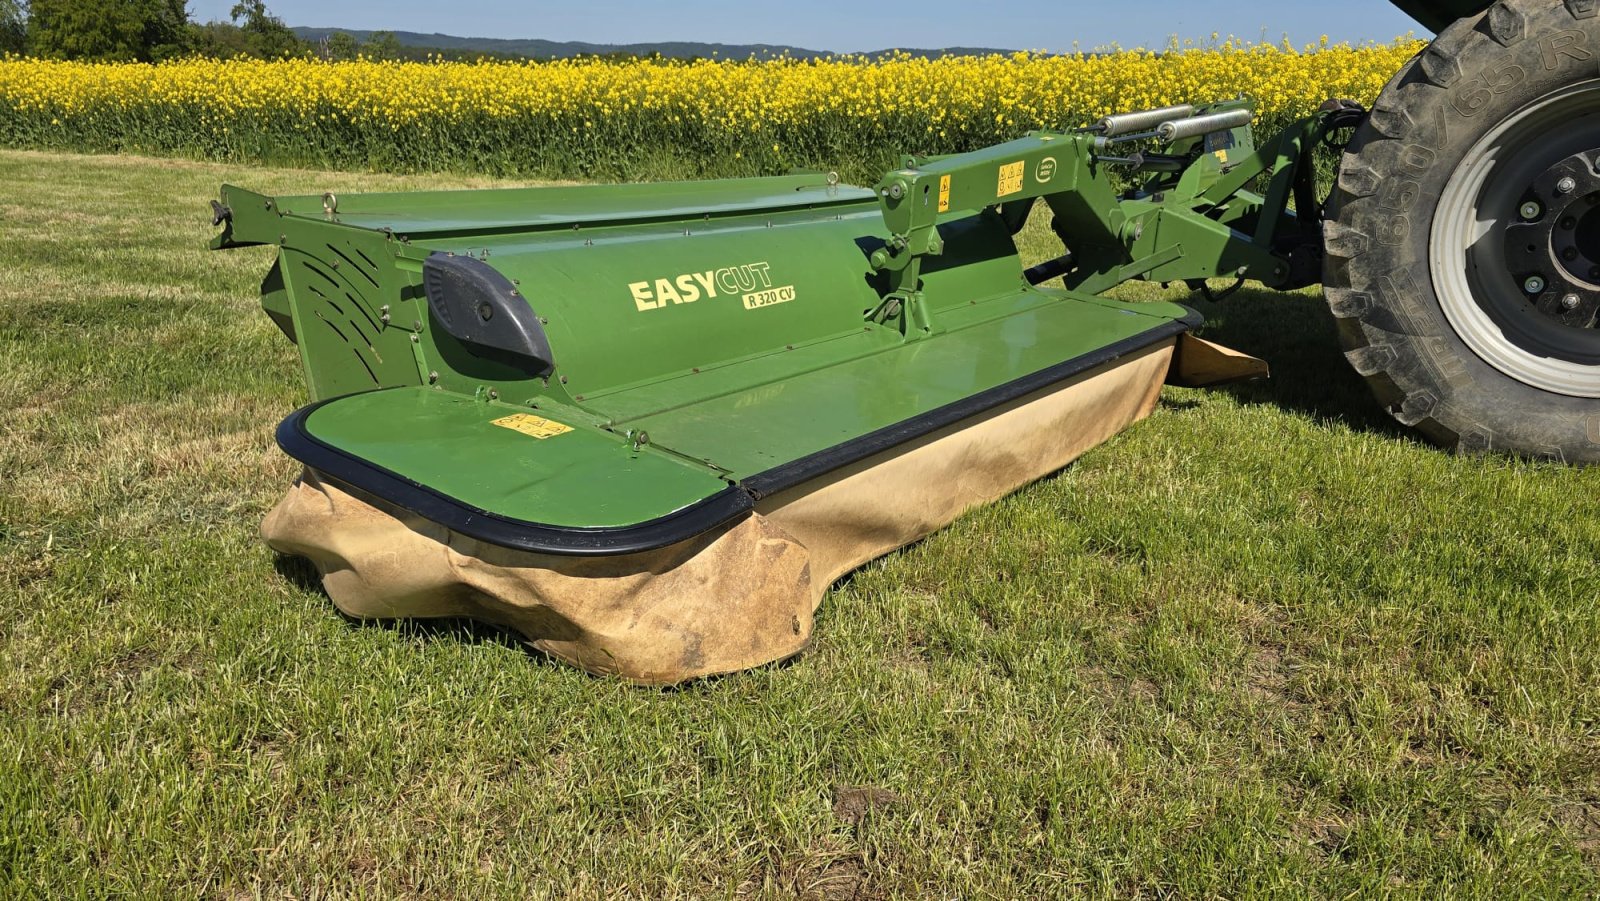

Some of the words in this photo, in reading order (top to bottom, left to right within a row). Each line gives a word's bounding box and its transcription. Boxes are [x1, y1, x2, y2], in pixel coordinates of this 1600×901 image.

[1537, 29, 1592, 71] R
[629, 262, 771, 312] EASYCUT
[748, 295, 757, 307] R
[759, 291, 777, 305] 320
[779, 287, 792, 302] CV
